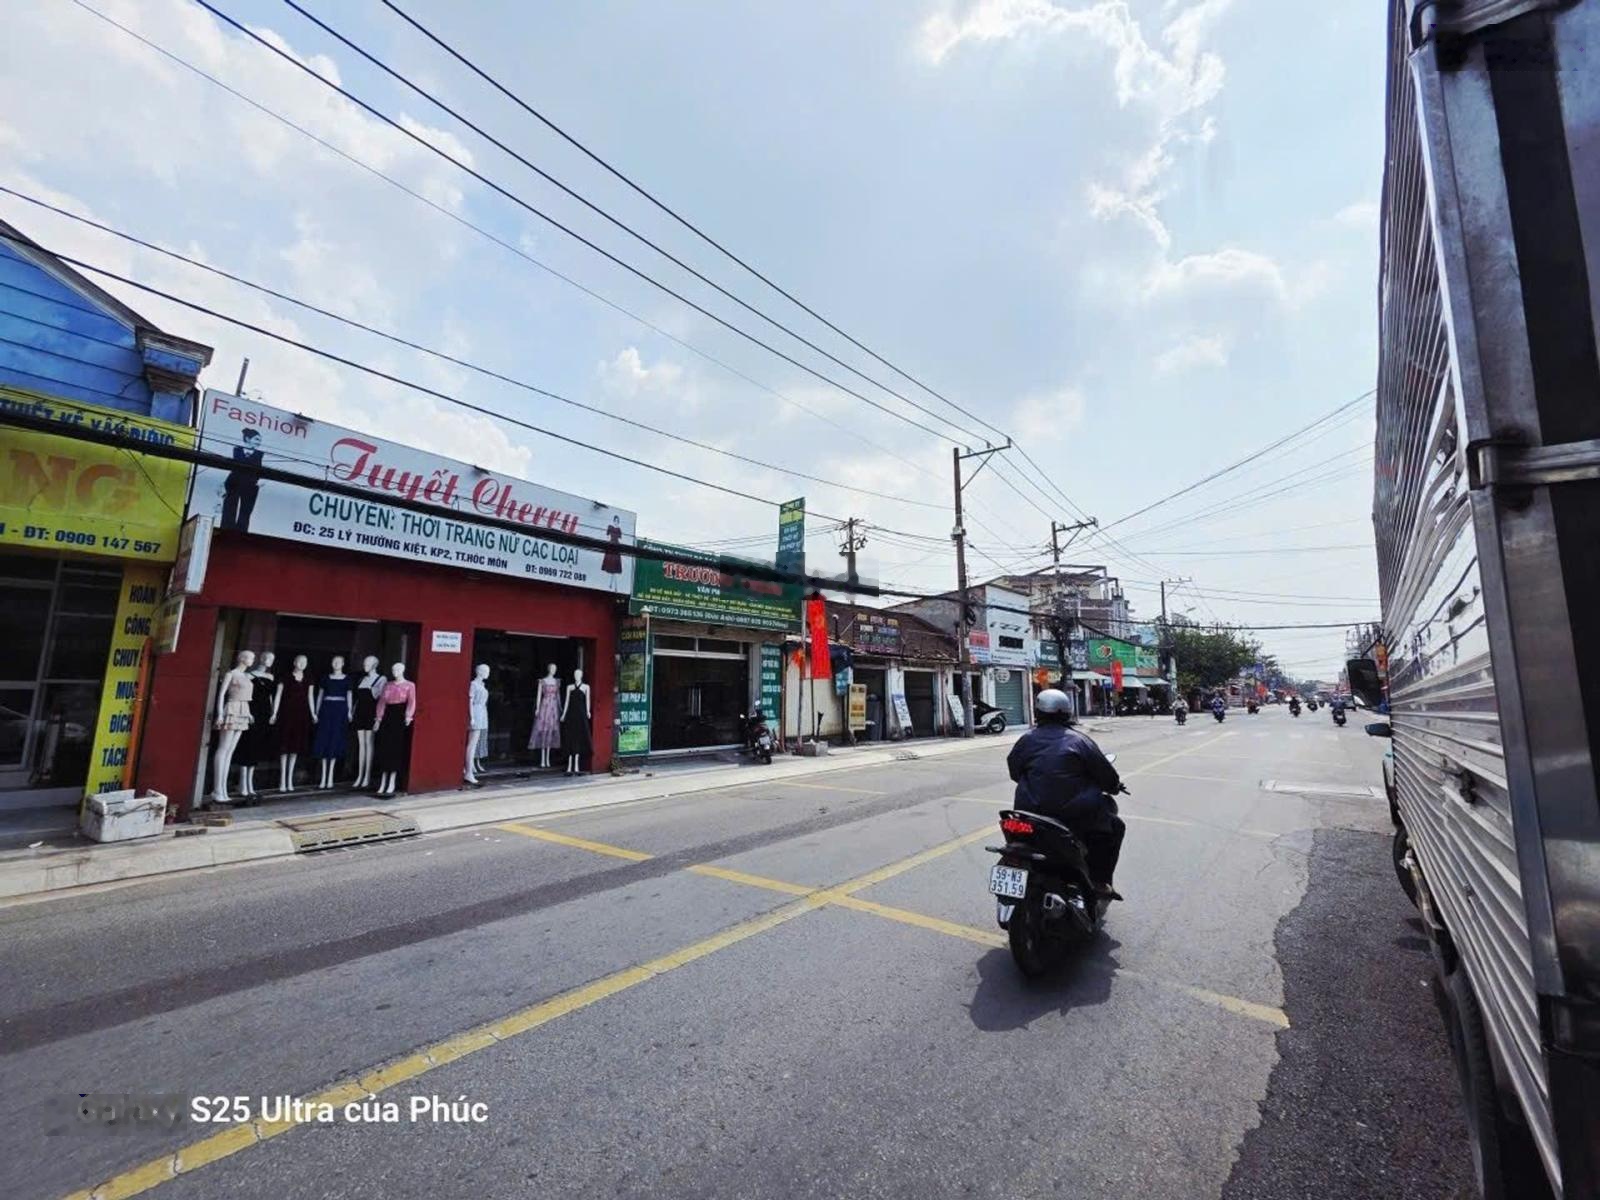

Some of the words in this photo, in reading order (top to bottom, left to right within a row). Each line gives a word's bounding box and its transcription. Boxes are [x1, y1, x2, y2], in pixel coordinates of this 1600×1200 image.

[212, 397, 308, 439] Fashion
[331, 437, 460, 503] Tuyết
[23, 525, 51, 540] ĐT:
[55, 529, 96, 546] 0909
[102, 536, 130, 550] 147
[133, 539, 161, 554] 567
[293, 521, 316, 535] ĐC:
[318, 526, 335, 539] 25
[338, 528, 353, 542] LÝ
[445, 521, 496, 550] TRANG
[991, 880, 1024, 896] 351.59
[996, 869, 1023, 882] 59-N3
